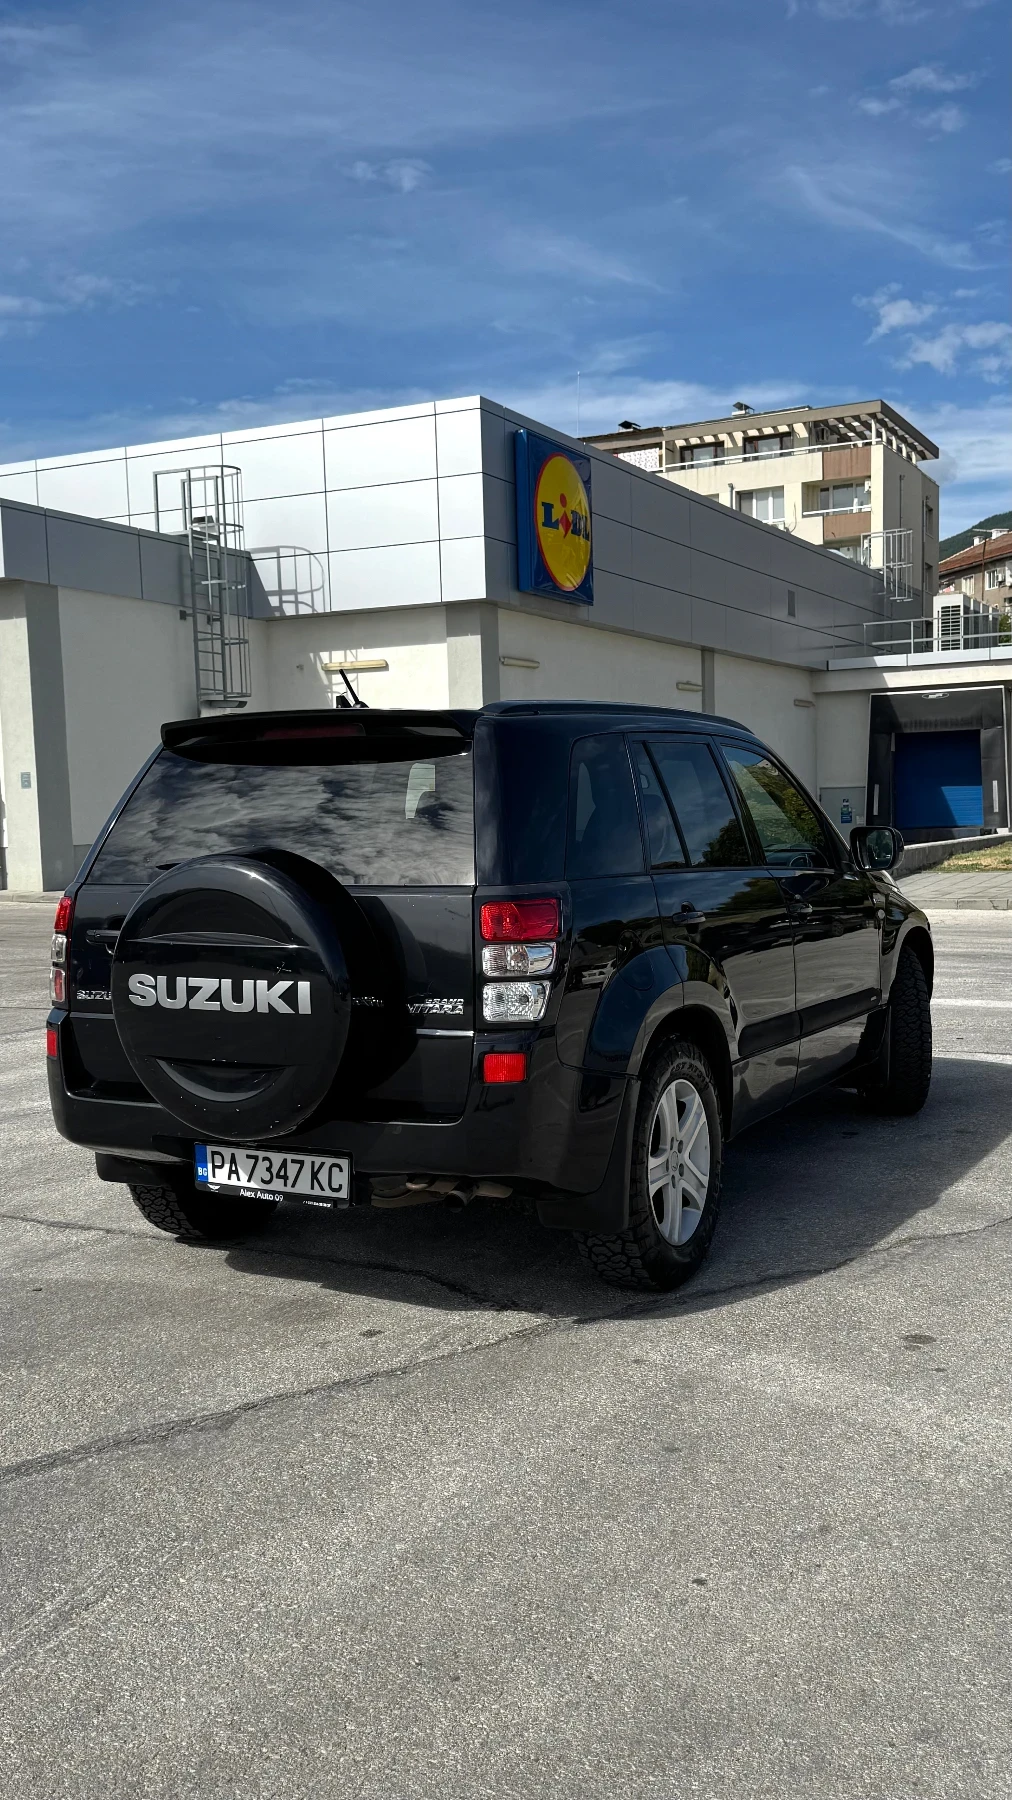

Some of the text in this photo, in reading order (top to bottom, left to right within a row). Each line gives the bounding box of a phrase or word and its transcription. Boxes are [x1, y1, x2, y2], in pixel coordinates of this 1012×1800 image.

[77, 990, 112, 1000] SUZU
[128, 973, 312, 1015] SUZUKI
[197, 1166, 208, 1176] BG
[239, 1188, 256, 1199] Alex
[256, 1190, 274, 1201] Auto
